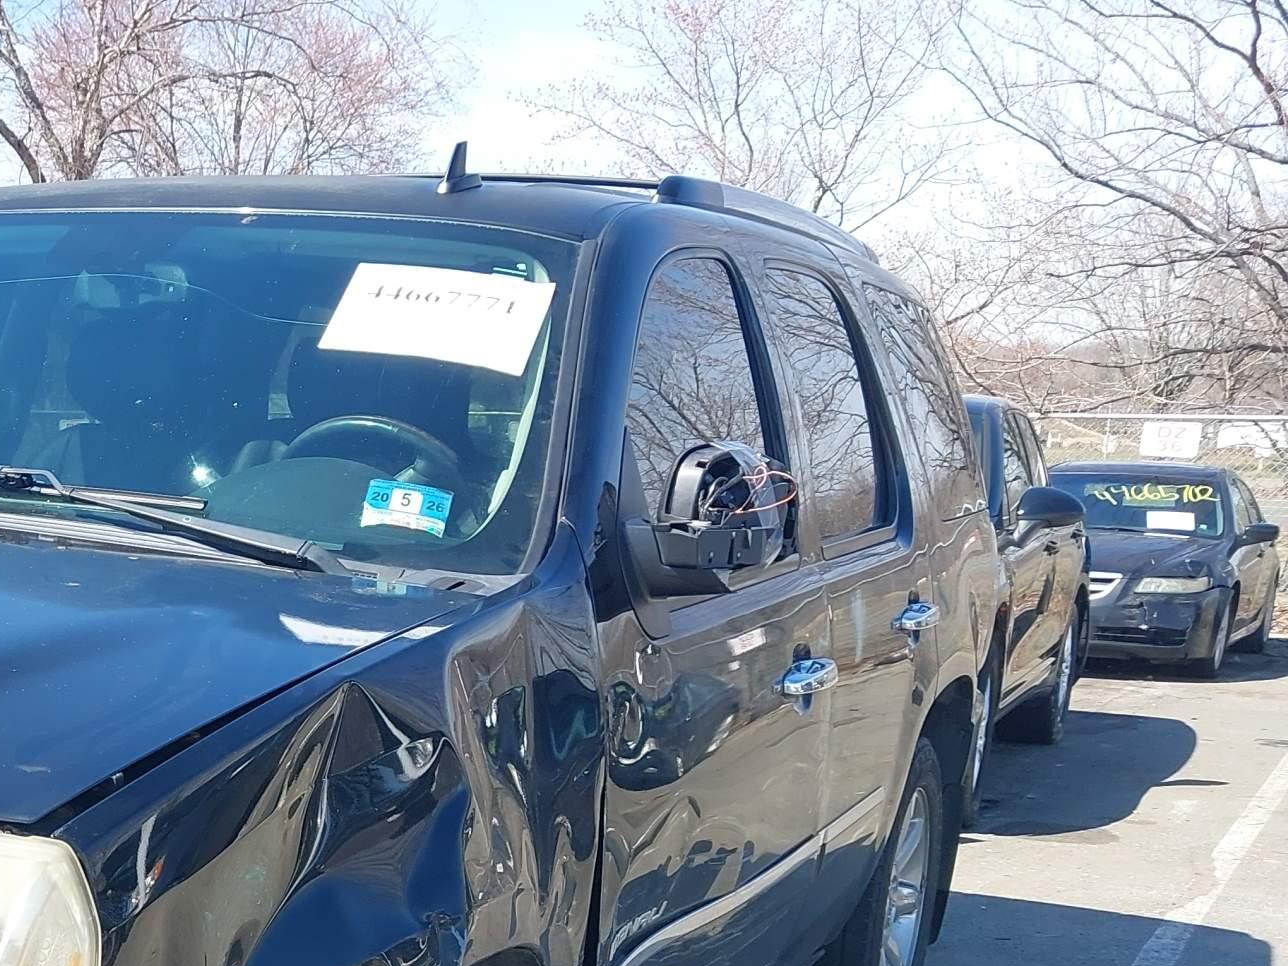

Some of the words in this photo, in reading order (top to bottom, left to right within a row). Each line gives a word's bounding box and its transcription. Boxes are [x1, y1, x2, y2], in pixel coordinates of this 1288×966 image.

[368, 285, 516, 314] 44667771
[371, 491, 390, 503] 20
[400, 493, 412, 507] 5
[426, 500, 446, 513] 26
